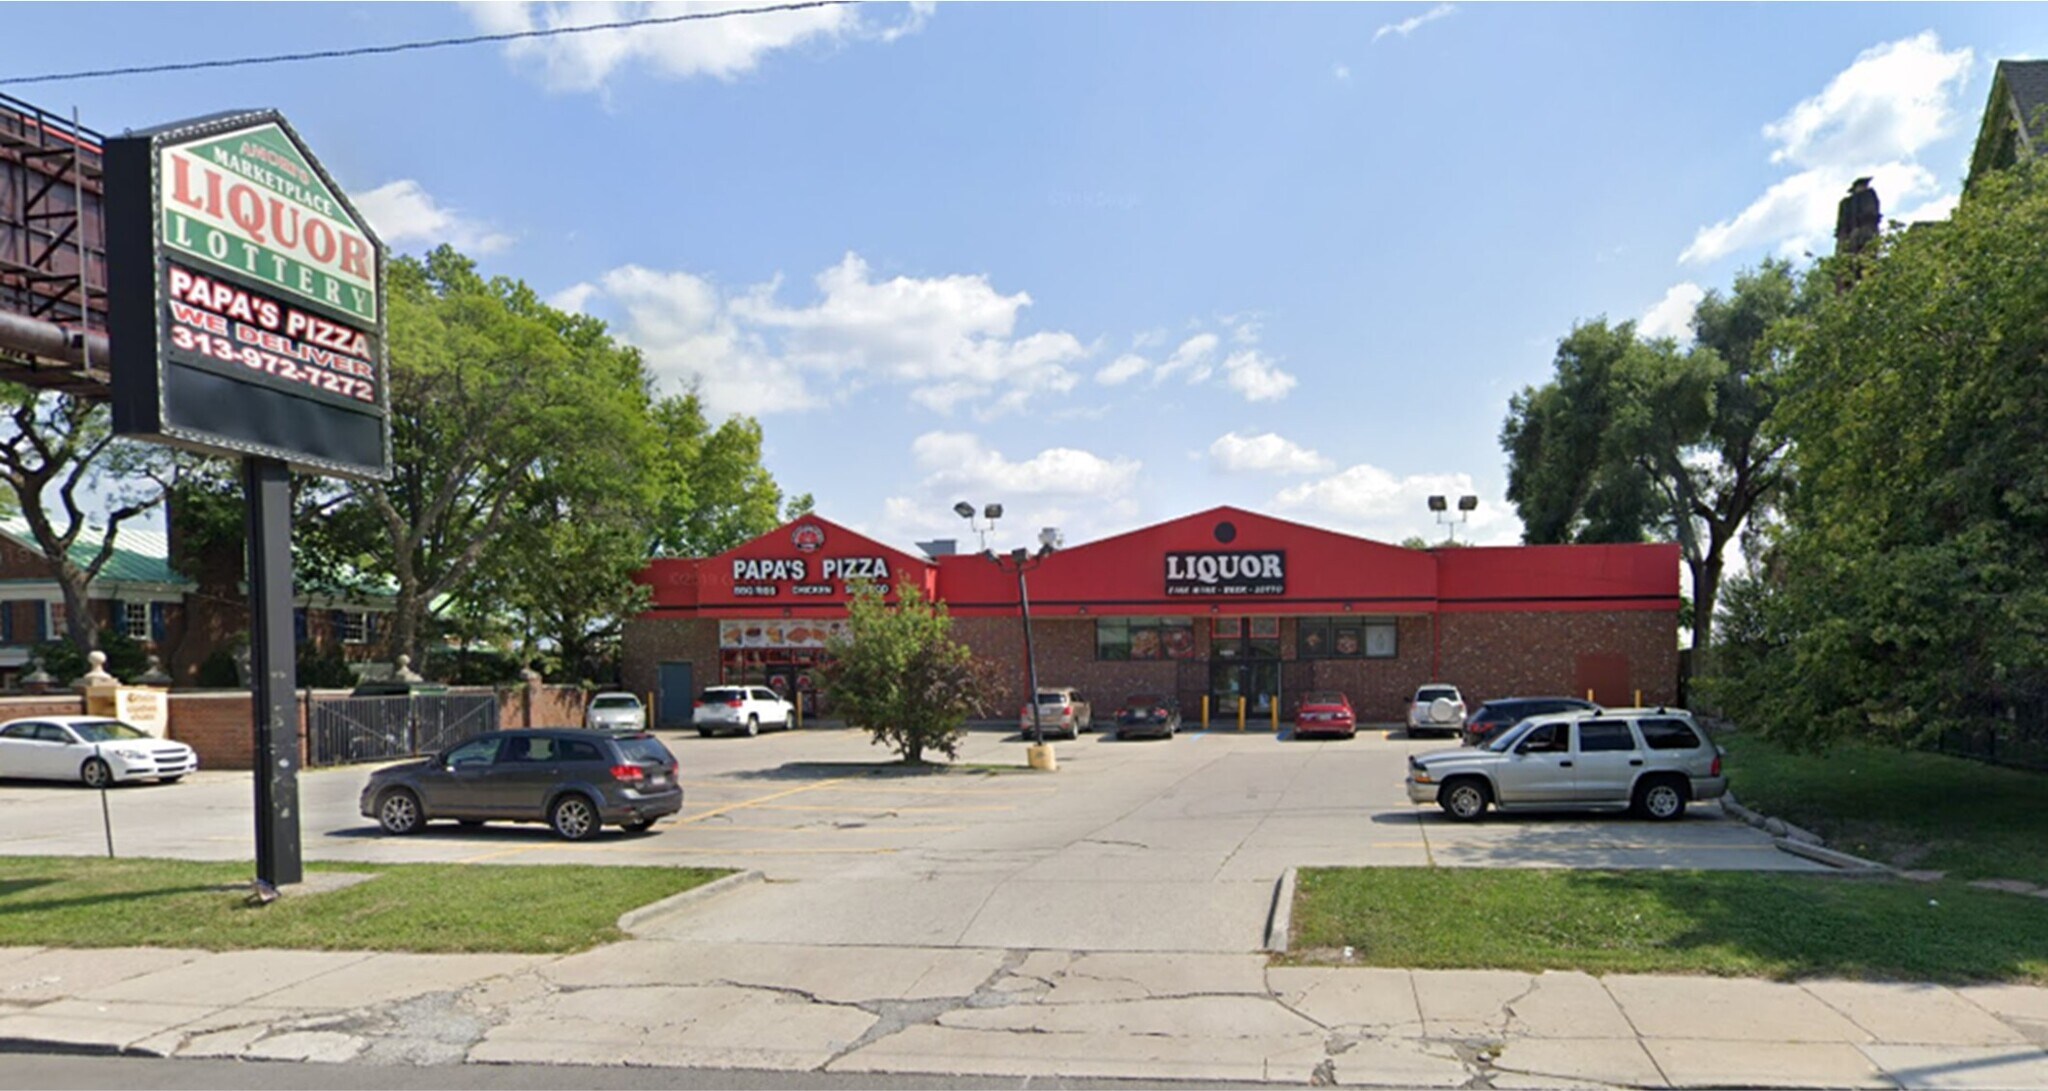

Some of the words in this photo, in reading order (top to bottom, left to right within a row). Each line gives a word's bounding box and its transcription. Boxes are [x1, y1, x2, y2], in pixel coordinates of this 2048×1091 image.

[171, 154, 371, 281] LIQUOR
[213, 146, 333, 216] MARKETPLACE
[176, 214, 367, 313] LOTTERY
[169, 266, 281, 331] PAPA'S
[286, 309, 372, 362] PIZZA
[169, 299, 230, 338] WE
[235, 322, 375, 381] DELIVER
[172, 325, 375, 402] 313-972-7272
[733, 559, 806, 580] PAPA'S
[822, 557, 890, 579] PIZZA
[792, 585, 833, 596] CHICKEN
[1166, 554, 1284, 584] LIQUOR
